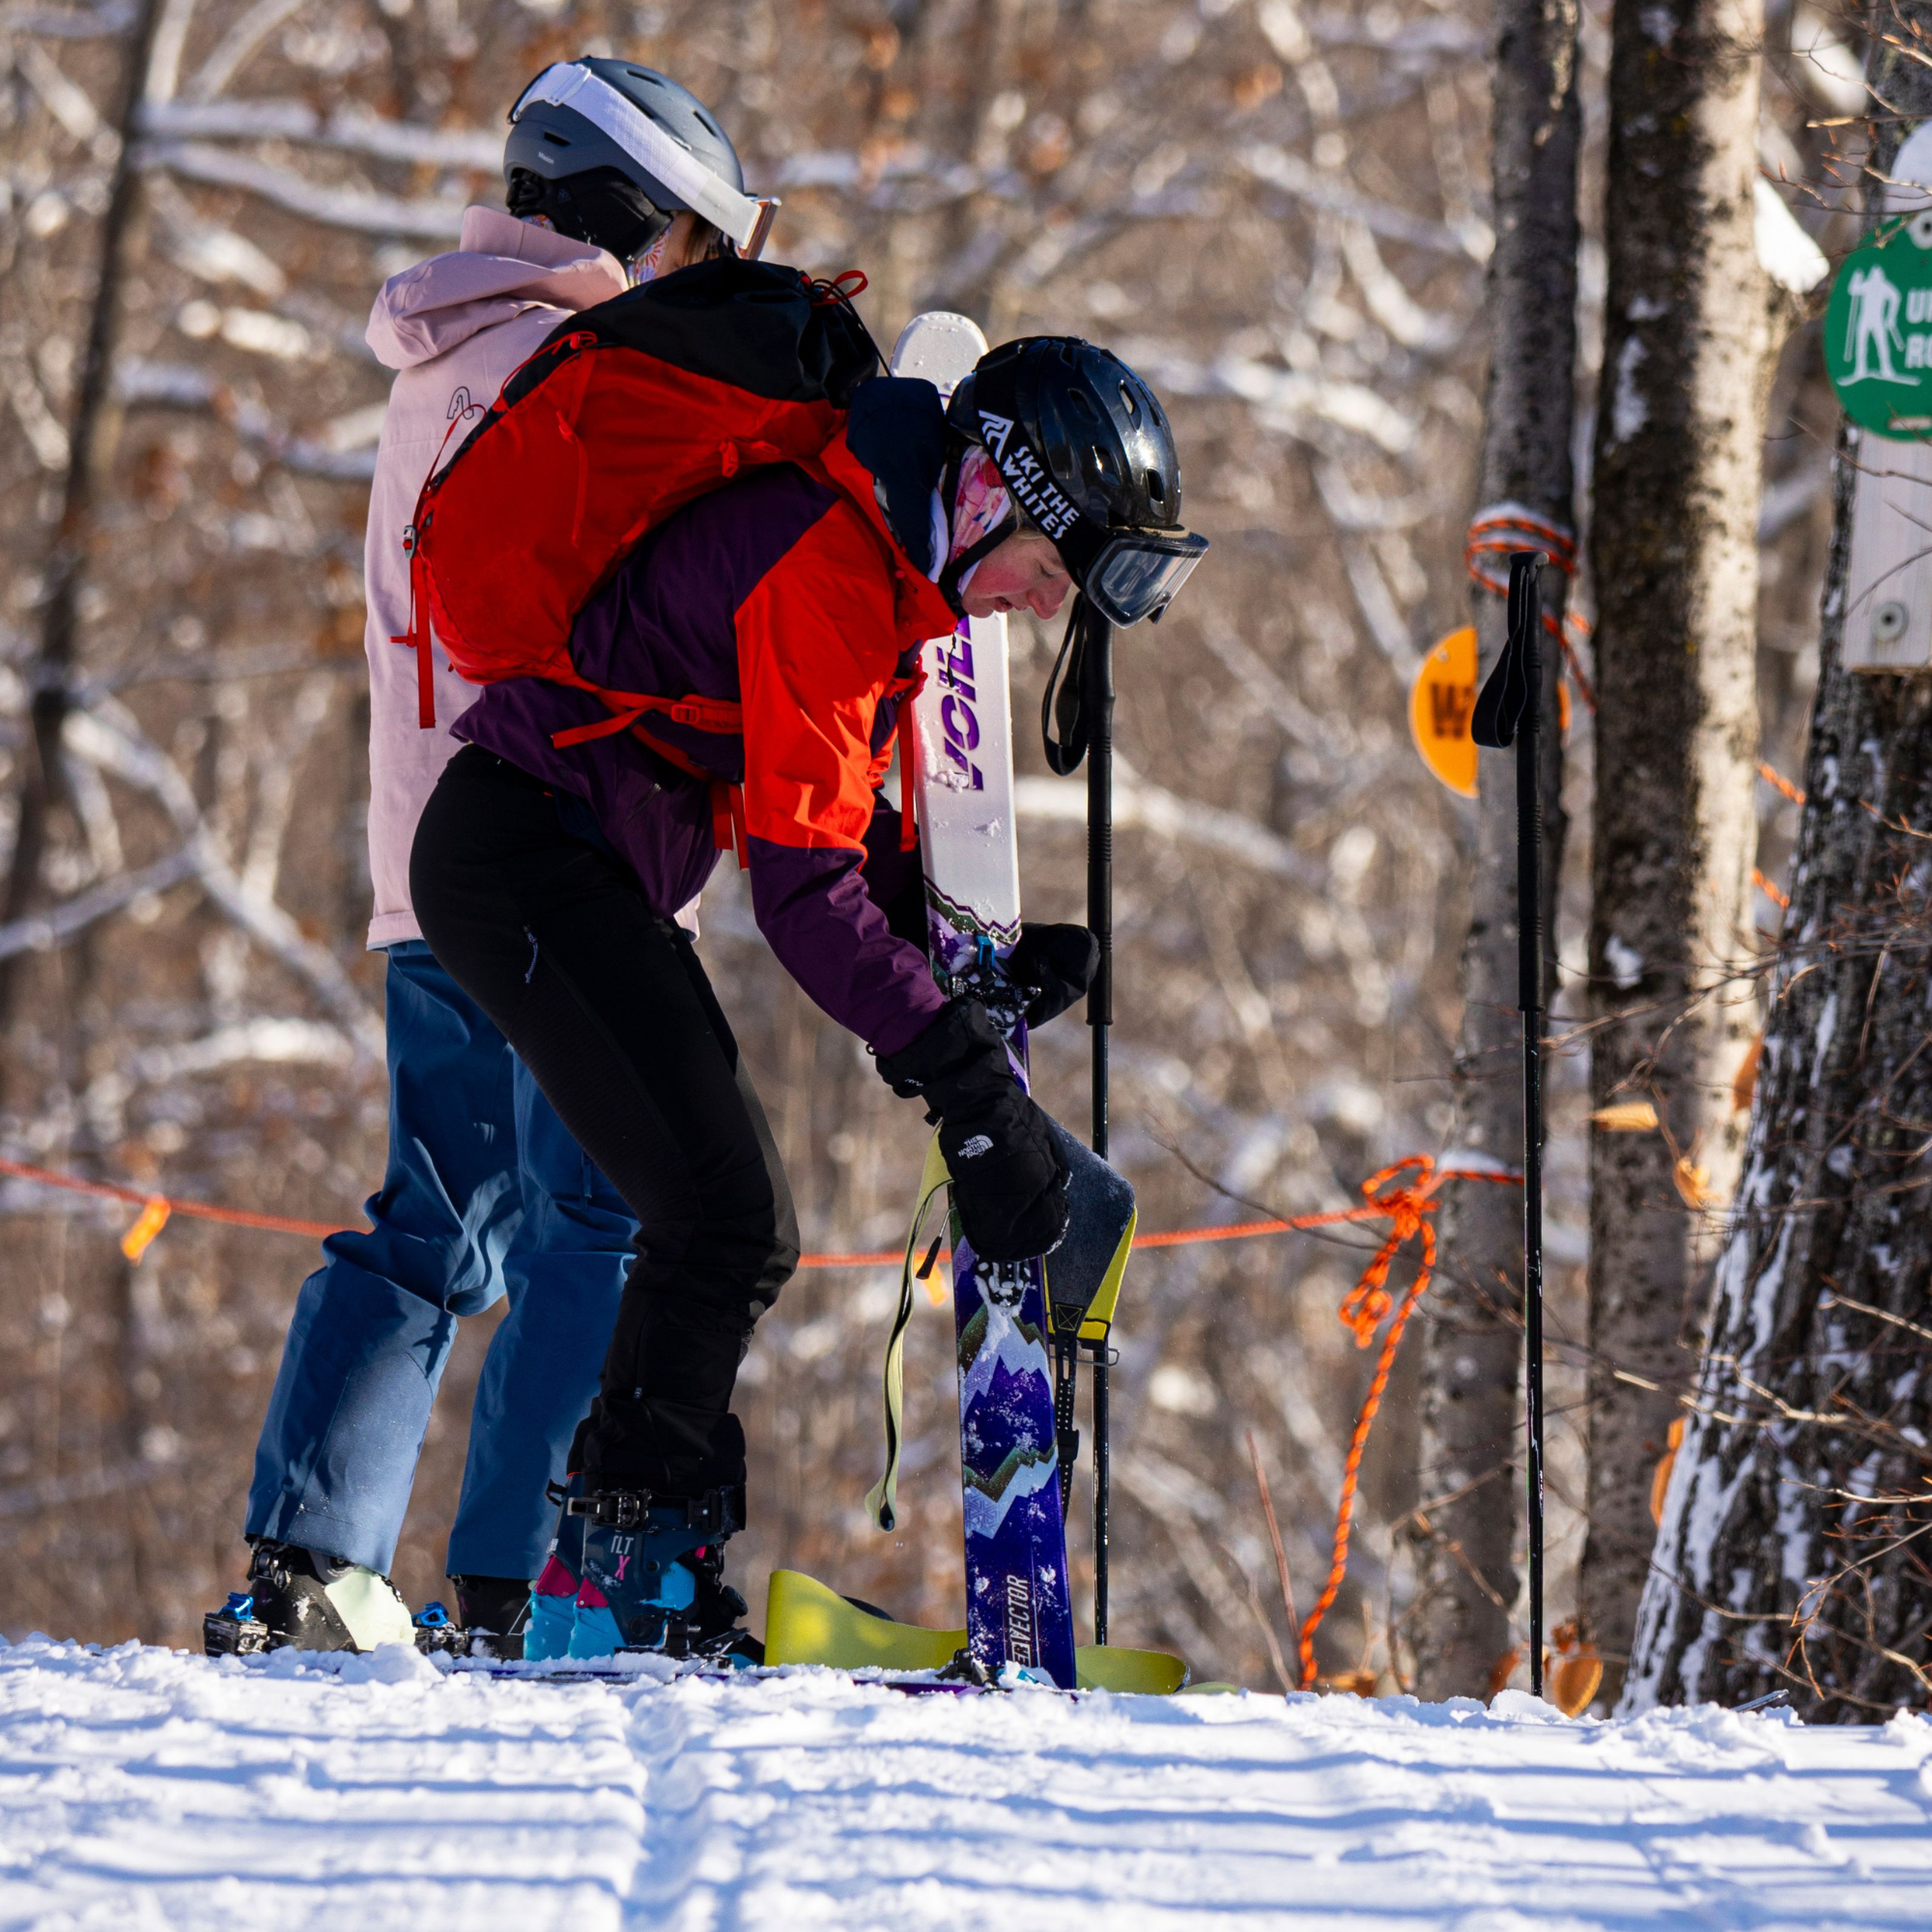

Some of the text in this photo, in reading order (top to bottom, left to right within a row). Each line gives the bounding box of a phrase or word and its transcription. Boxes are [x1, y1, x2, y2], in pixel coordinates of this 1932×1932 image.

[1003, 454, 1067, 539] WHITES
[1014, 445, 1080, 526] SKI THE
[936, 614, 984, 791] VOIL
